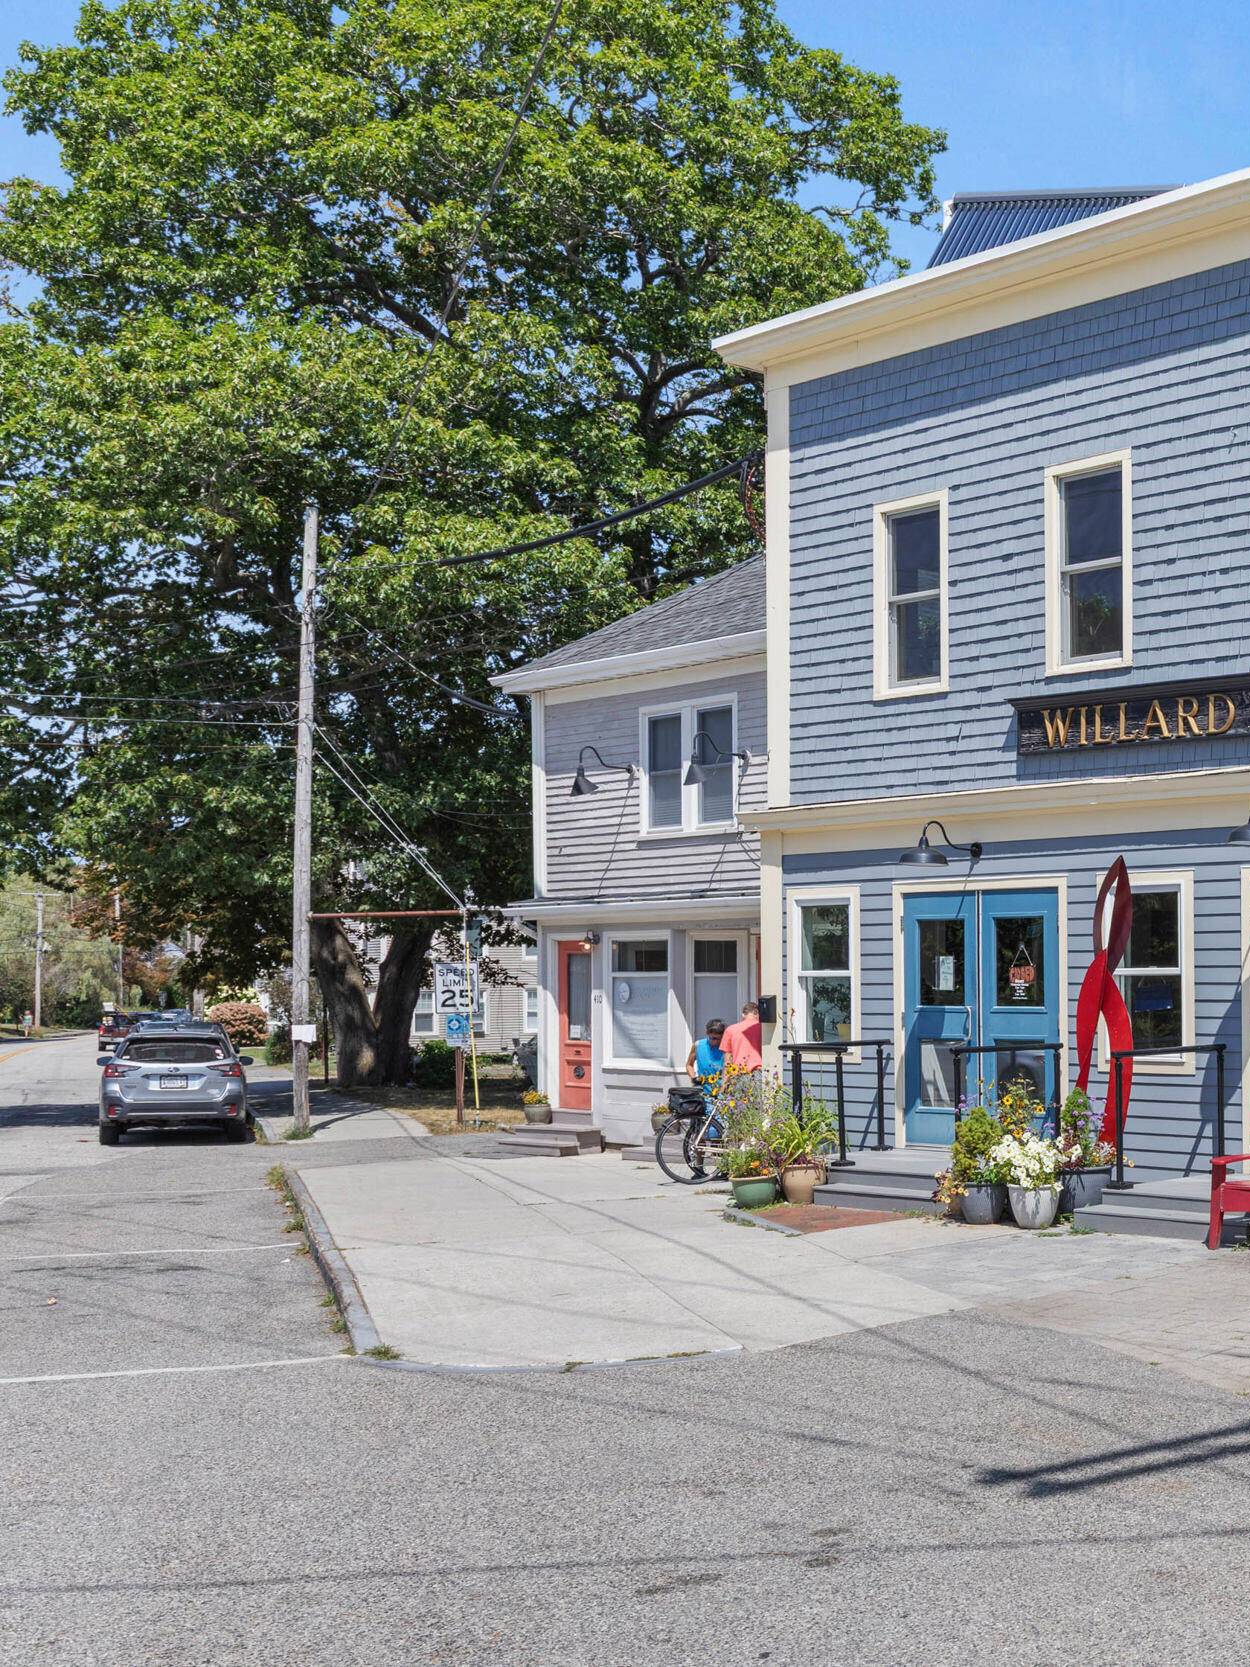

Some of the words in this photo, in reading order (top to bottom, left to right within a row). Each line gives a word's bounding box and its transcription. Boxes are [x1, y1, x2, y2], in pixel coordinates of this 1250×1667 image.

[1041, 692, 1236, 749] WILLARD
[438, 968, 475, 977] SPEED
[441, 989, 474, 1008] 25
[593, 994, 603, 1004] 410
